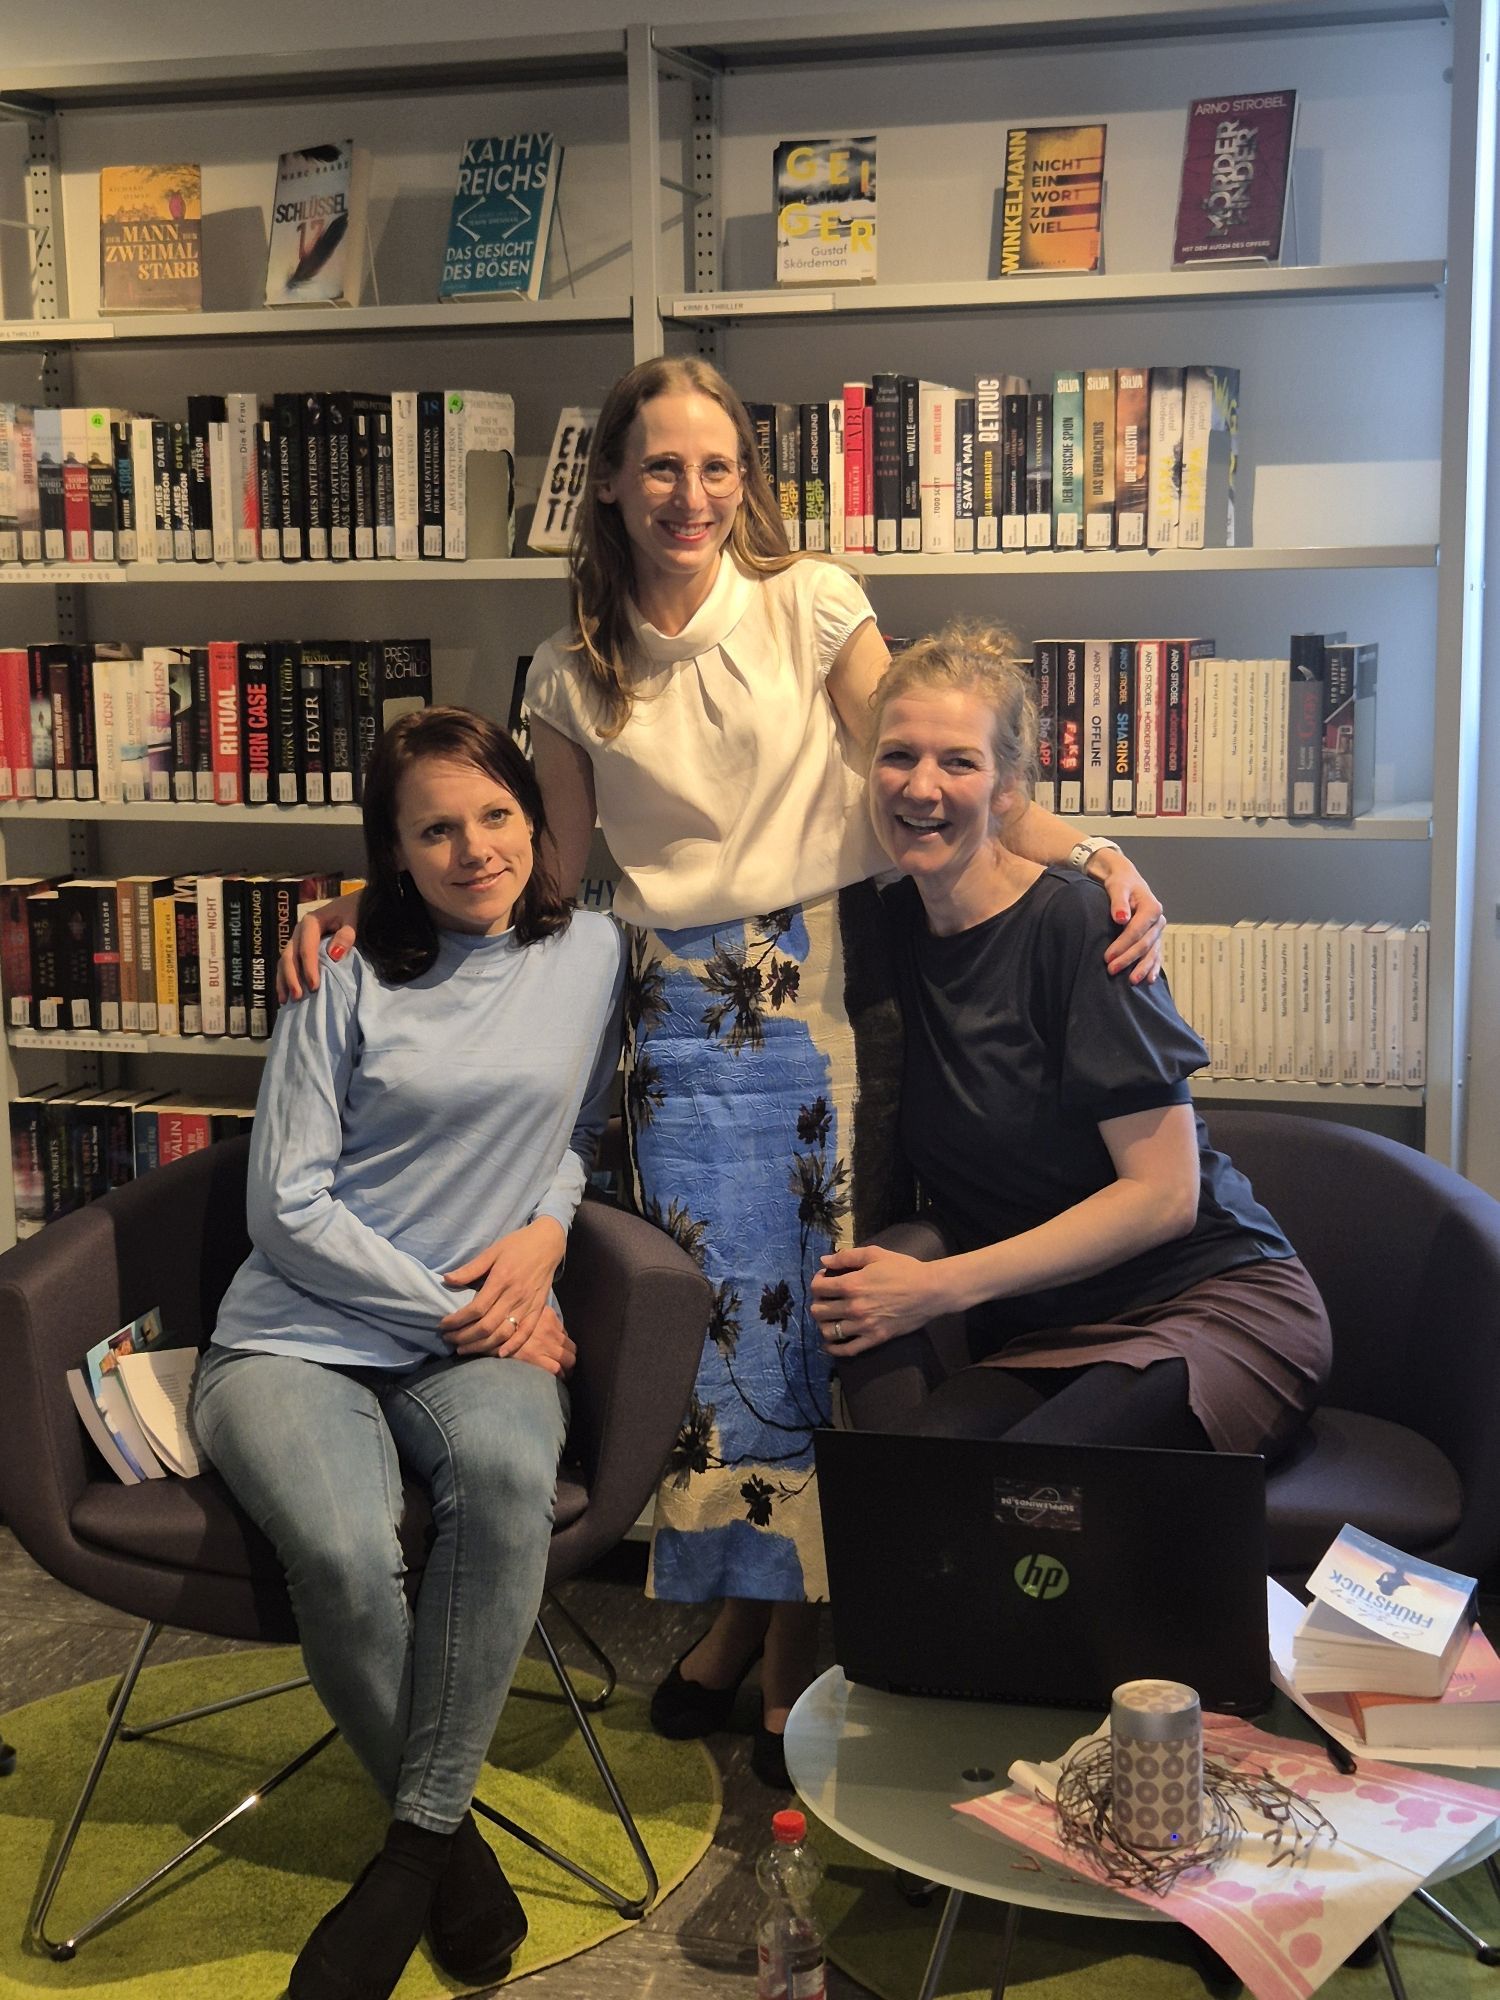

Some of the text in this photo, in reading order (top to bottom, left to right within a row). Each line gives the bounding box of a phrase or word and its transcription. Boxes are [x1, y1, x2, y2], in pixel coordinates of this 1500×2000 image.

[1194, 96, 1287, 116] ARNO STROBEL
[461, 132, 554, 165] KATHY
[1032, 159, 1082, 172] NICHT
[455, 161, 548, 196] REICHS
[1032, 175, 1059, 188] EIN
[1202, 120, 1239, 236] MÖRDER
[275, 192, 348, 224] SCHLÜSSEL
[1002, 131, 1028, 273] WINKELMANN
[1030, 207, 1052, 219] ZU
[1031, 189, 1080, 203] WORT
[122, 224, 179, 243] MANN
[1029, 222, 1065, 234] VIEL
[105, 243, 199, 263] ZWEIMAL
[446, 241, 534, 262] DAS GESICHT
[783, 257, 847, 270] Skördeman
[811, 243, 848, 257] Gustaf
[138, 261, 200, 280] STARB
[442, 257, 530, 282] DES BÖSEN
[1057, 379, 1079, 393] SILVA
[1087, 376, 1109, 391] SILVA
[1121, 375, 1143, 389] SILVA
[239, 402, 247, 423] Frau
[978, 379, 1000, 442] BETRUG
[846, 407, 863, 452] TABU
[157, 437, 165, 468] DARK
[175, 437, 183, 469] DEVIL
[281, 436, 291, 496] PATTERSON
[309, 436, 318, 496] PATTERSON
[331, 434, 340, 494] PATTERSON
[408, 434, 416, 476] STUNDE
[963, 433, 973, 464] MAN
[1062, 417, 1074, 503] DER RUSSISCHE SPION
[1093, 421, 1104, 495] DAS VERMÄCHTNIS
[1124, 425, 1137, 482] DIE CELLISTIN
[120, 459, 131, 495] STORM
[424, 429, 432, 512] JAMES PATTERSON
[551, 461, 586, 496] GU
[963, 467, 973, 477] A
[155, 485, 163, 518] JAMES
[162, 472, 172, 530] PATTERSON
[173, 485, 181, 518] JAMES
[180, 473, 190, 531] PATTERSON
[805, 481, 815, 520] EMELIE
[963, 480, 973, 509] SAW
[1067, 649, 1075, 706] ARNO STROBEL
[1119, 648, 1128, 704] ARNO STROBEL
[1169, 649, 1178, 671] ARNO
[359, 661, 368, 696] FEAR
[1041, 652, 1050, 708] ARNO STROBEL
[1093, 651, 1101, 708] ARNO STROBEL
[1169, 673, 1178, 706] STROBEL
[154, 661, 166, 733] STIMMEN
[250, 683, 268, 728] CASE
[218, 684, 238, 755] RITUAL
[305, 695, 320, 753] FEVER
[1295, 692, 1318, 740] Gray
[1039, 714, 1051, 766] Die APP
[1060, 721, 1079, 769] FAKE
[1091, 715, 1102, 767] OFFLINE
[1116, 713, 1129, 773] SHARING
[102, 901, 110, 938] WÄLDER
[207, 897, 219, 929] NICHT
[230, 901, 242, 936] HÖLLE
[252, 889, 265, 955] KNOCHENJAGD
[166, 944, 174, 974] SOMMER
[207, 960, 219, 987] BLUT
[230, 958, 242, 987] FAHR
[252, 958, 265, 990] REICHS
[51, 1140, 60, 1181] ROBERTS
[1020, 1553, 1064, 1600] hp
[1329, 1569, 1435, 1630] FRÜHSTÜCK
